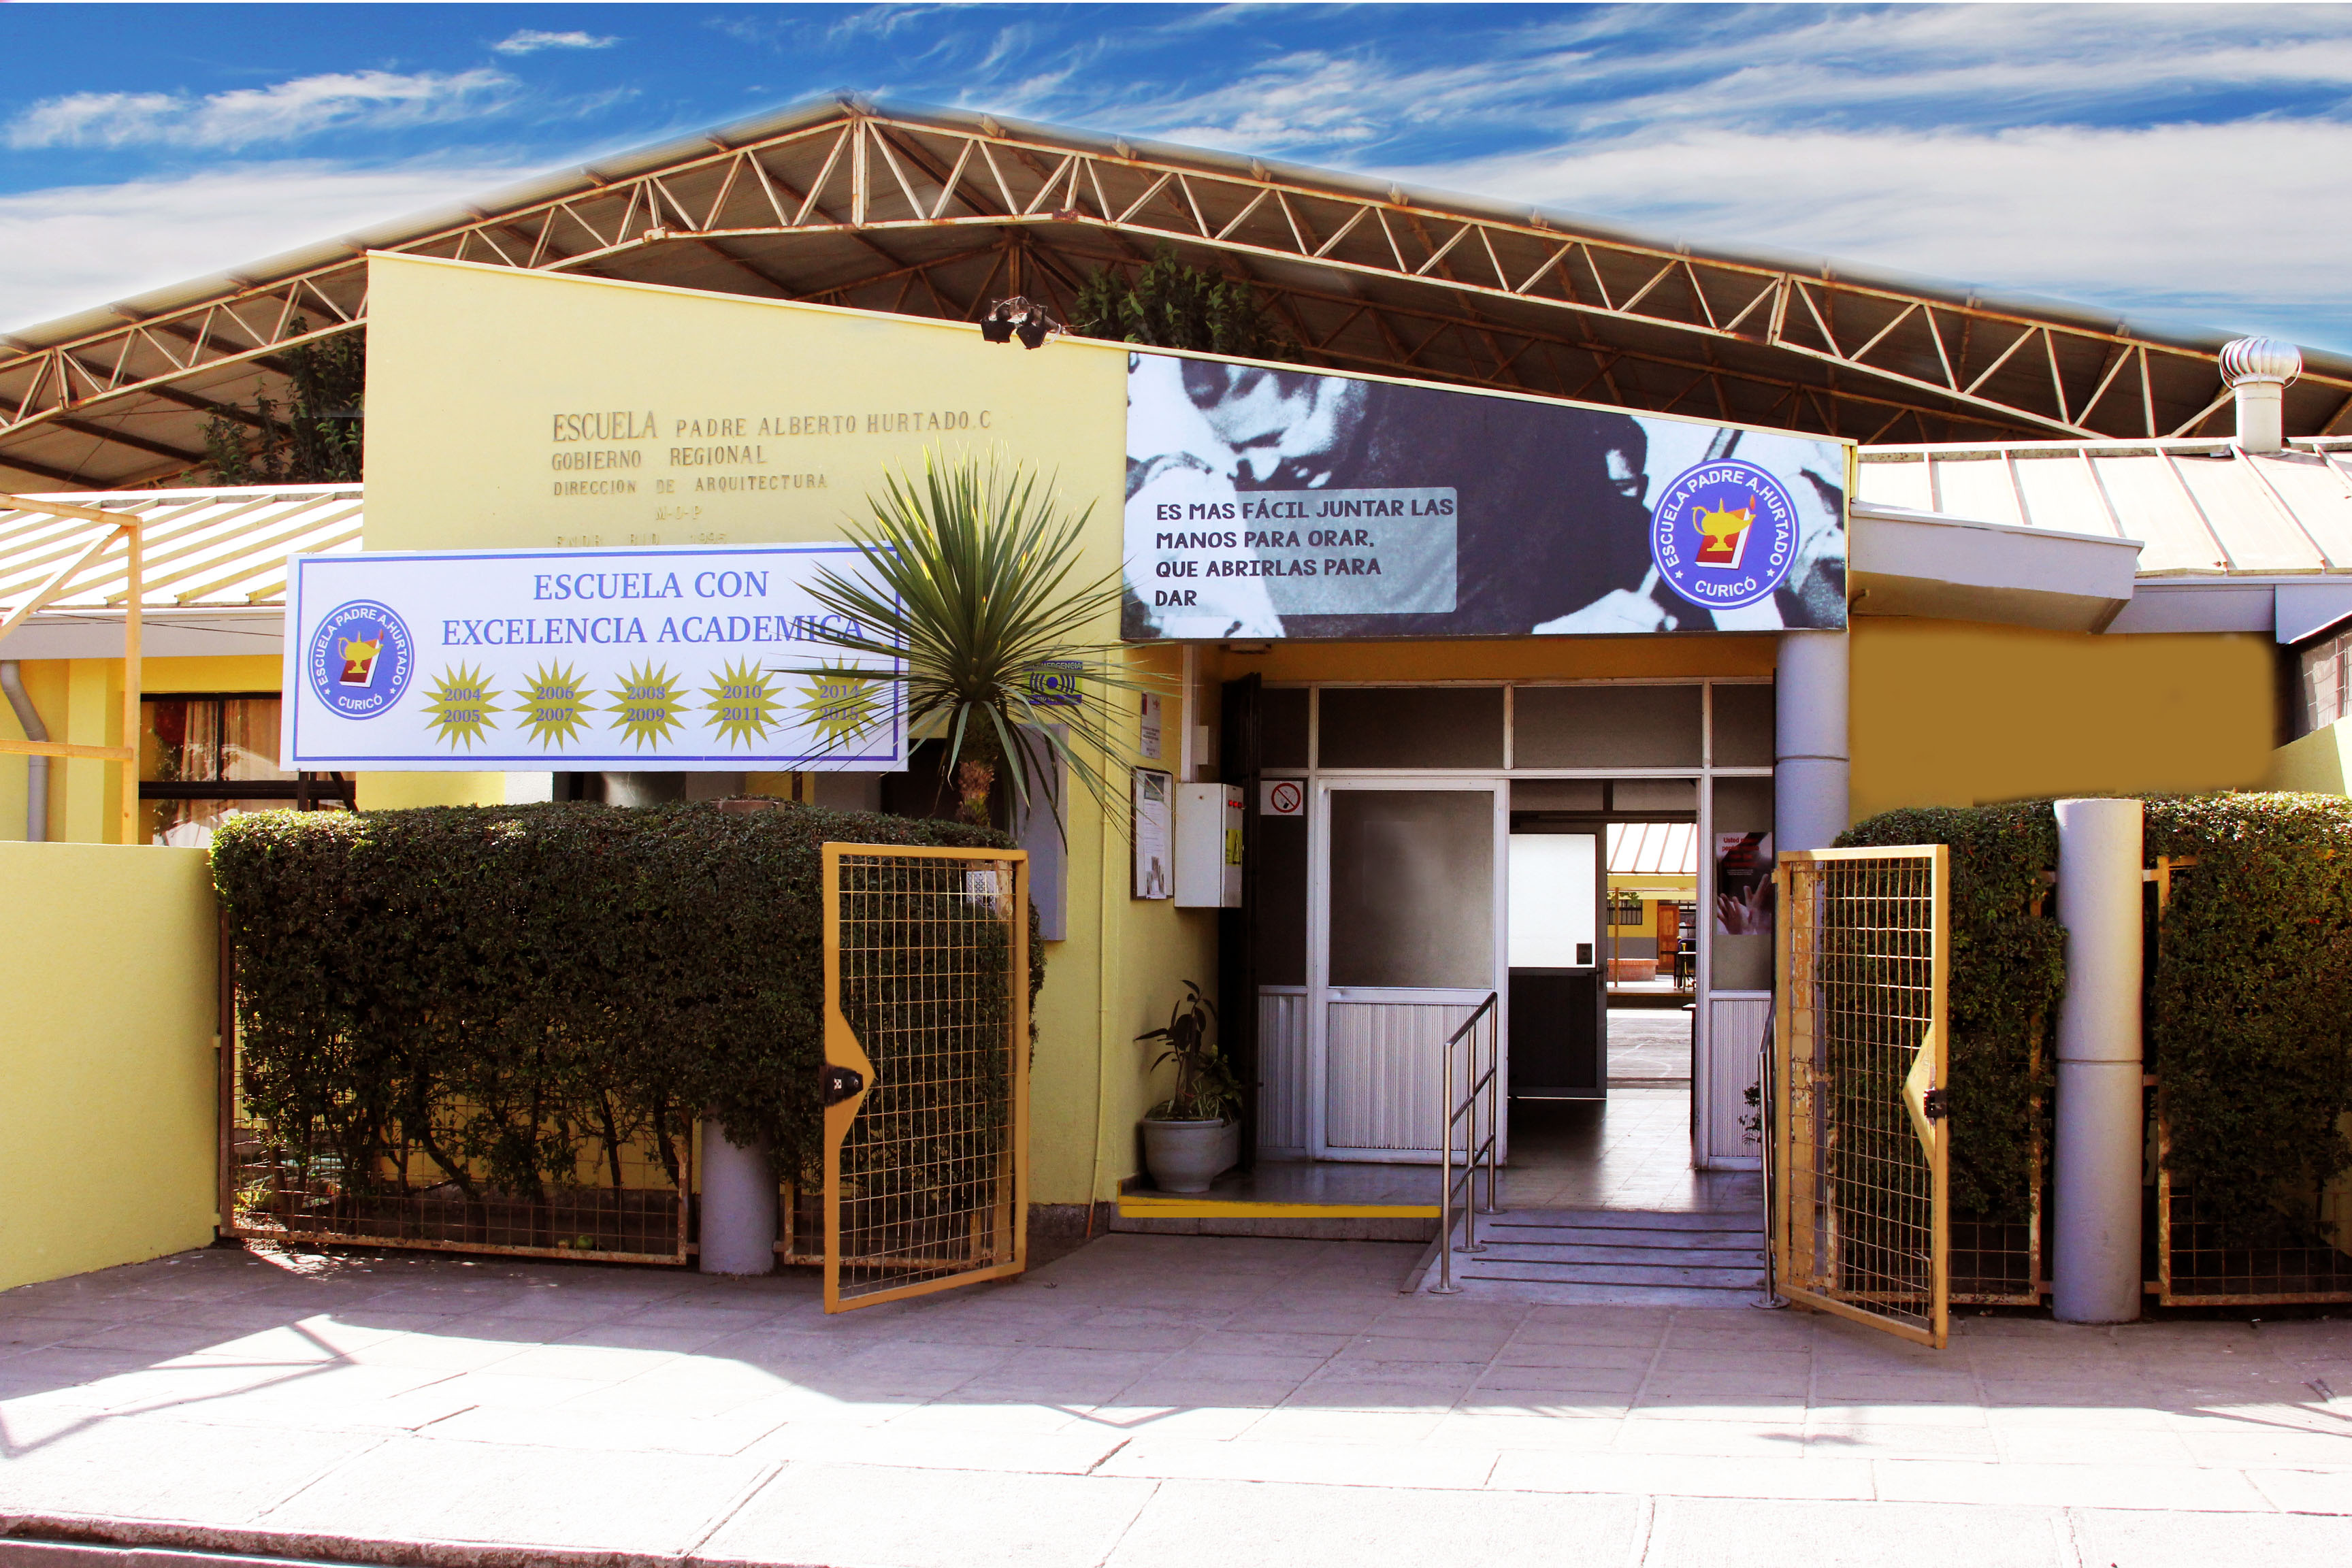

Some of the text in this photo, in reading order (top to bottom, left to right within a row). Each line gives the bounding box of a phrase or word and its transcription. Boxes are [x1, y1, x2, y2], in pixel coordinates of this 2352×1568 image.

[553, 410, 659, 442] ESCUELA
[676, 418, 746, 438] PADRE
[758, 415, 856, 436] ALBERTO
[552, 445, 768, 470] GOBIERNO REGIONAL
[554, 474, 828, 496] DIRECCION DE ARQUITECTURA
[1156, 498, 1454, 521] ES MAS FÁCIL JUNTAR LAS
[1661, 491, 1690, 568] ESCUELA
[1687, 470, 1745, 493] PADRE
[1156, 532, 1237, 549] MANOS
[1244, 531, 1301, 548] PARA
[1156, 558, 1382, 578] QUE ABRIRLAS PARA
[534, 570, 769, 600] ESCUELA CON
[1695, 576, 1757, 597] CURICÓ
[1156, 589, 1197, 606] DAR
[442, 615, 864, 645] EXCELENCIA ACADEMICA
[315, 625, 338, 686] ESCUELA
[336, 608, 377, 626] PADRE
[444, 687, 482, 702] 2004
[536, 686, 574, 700] 2006
[627, 685, 666, 700] 2008
[723, 685, 762, 699] 2010
[819, 685, 860, 698] 2014
[338, 693, 382, 710] CURICÓ
[443, 708, 480, 723] 2005
[536, 708, 574, 722] 2007
[626, 708, 666, 722] 2009
[722, 706, 760, 721] 2011
[819, 707, 859, 721] 2015
